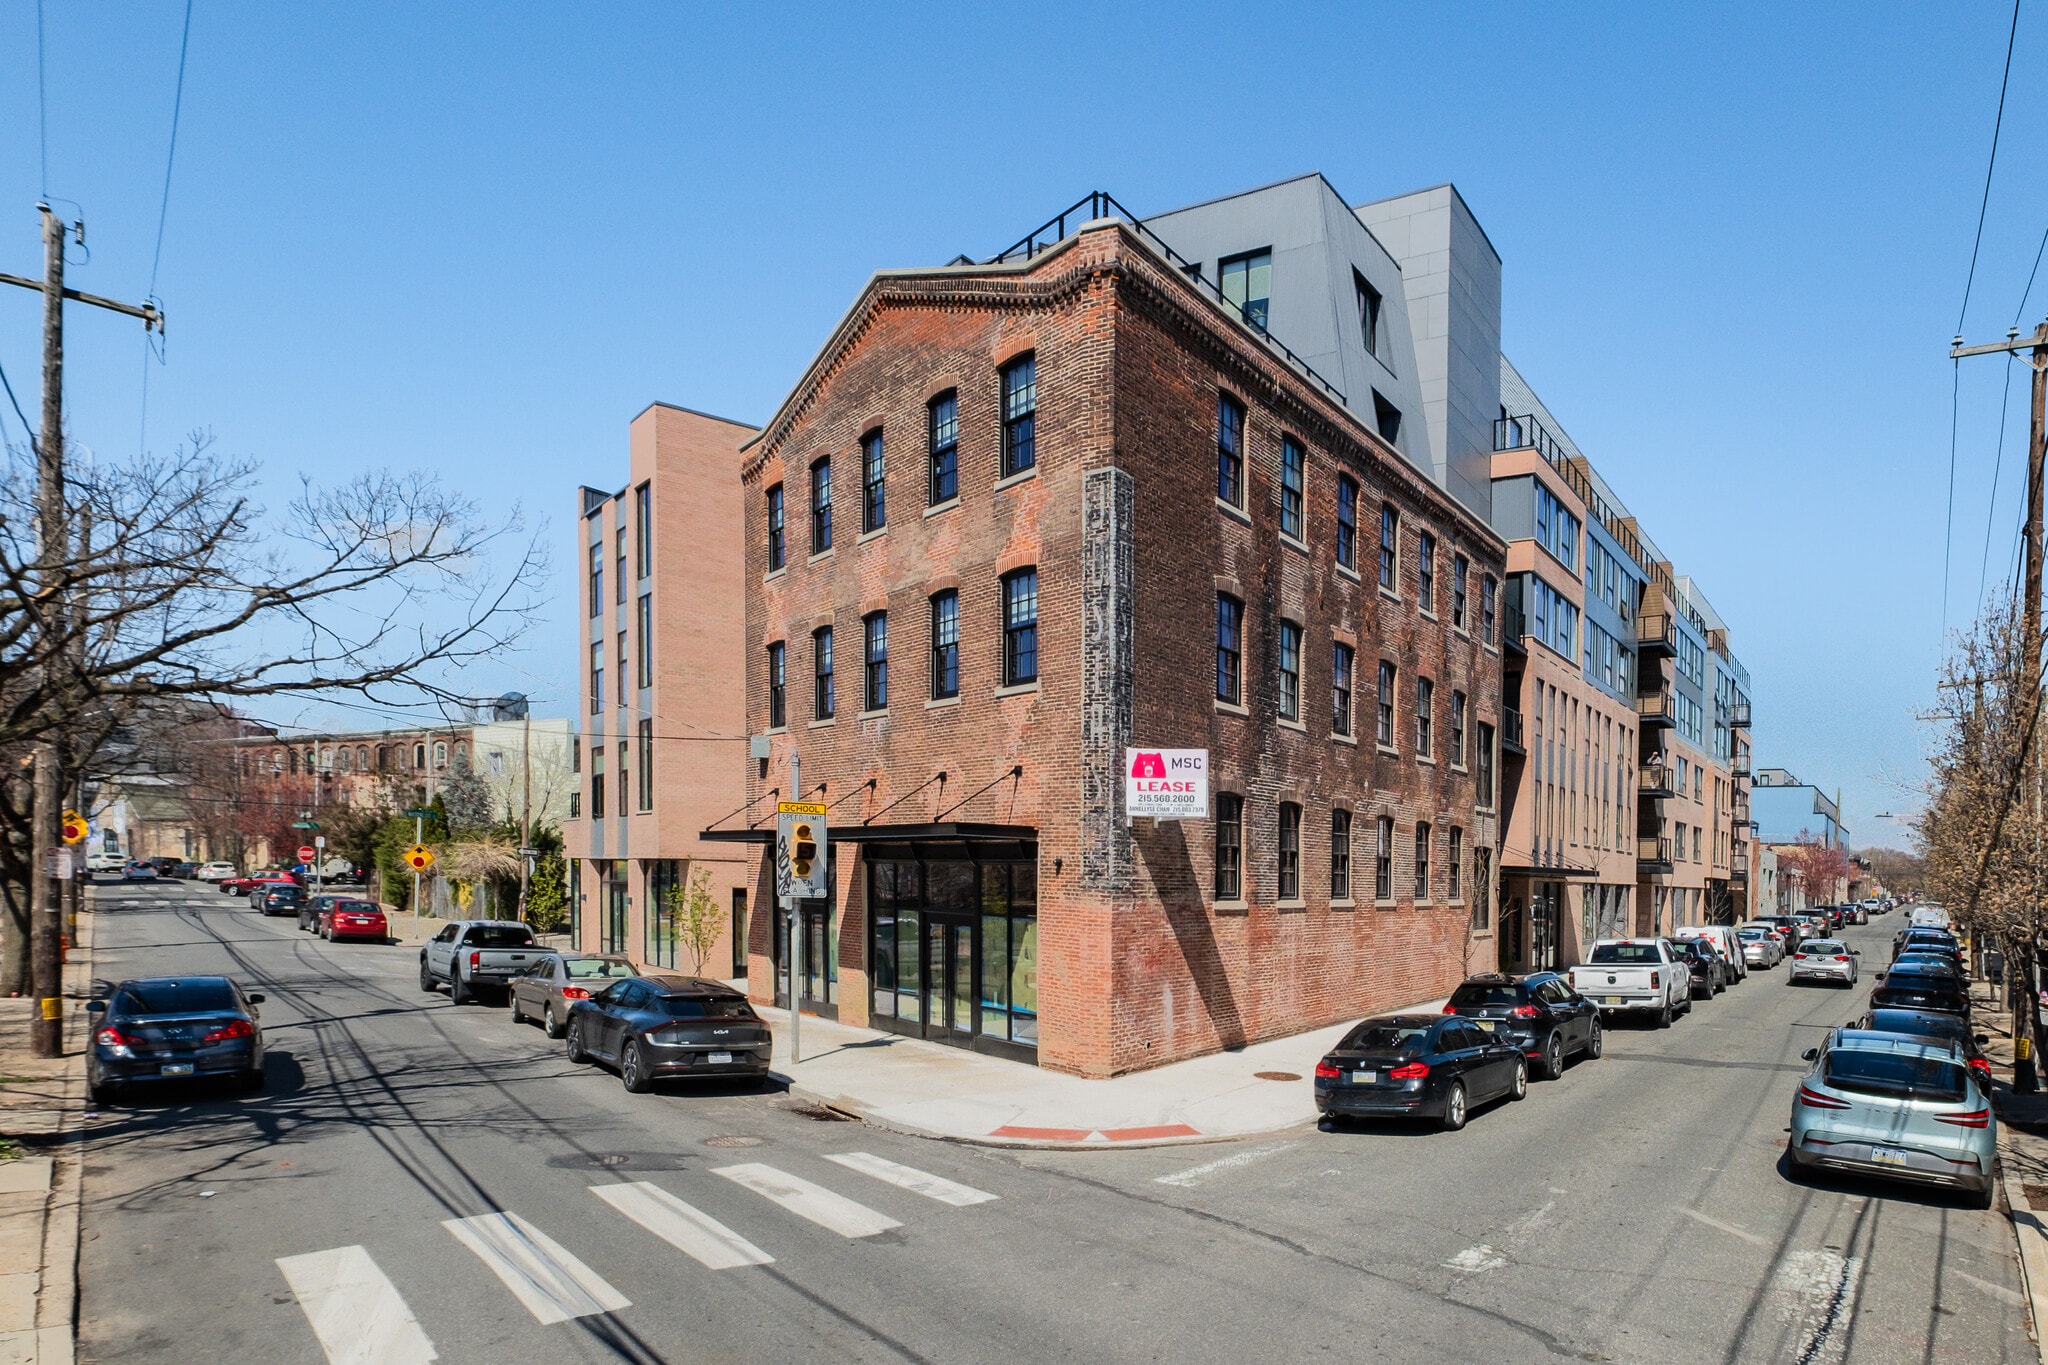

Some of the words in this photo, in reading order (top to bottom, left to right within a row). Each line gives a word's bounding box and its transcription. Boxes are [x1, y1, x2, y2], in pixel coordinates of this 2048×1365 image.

[1171, 757, 1202, 770] MSC
[1136, 781, 1196, 793] LEASE
[784, 804, 820, 814] SCHOOL
